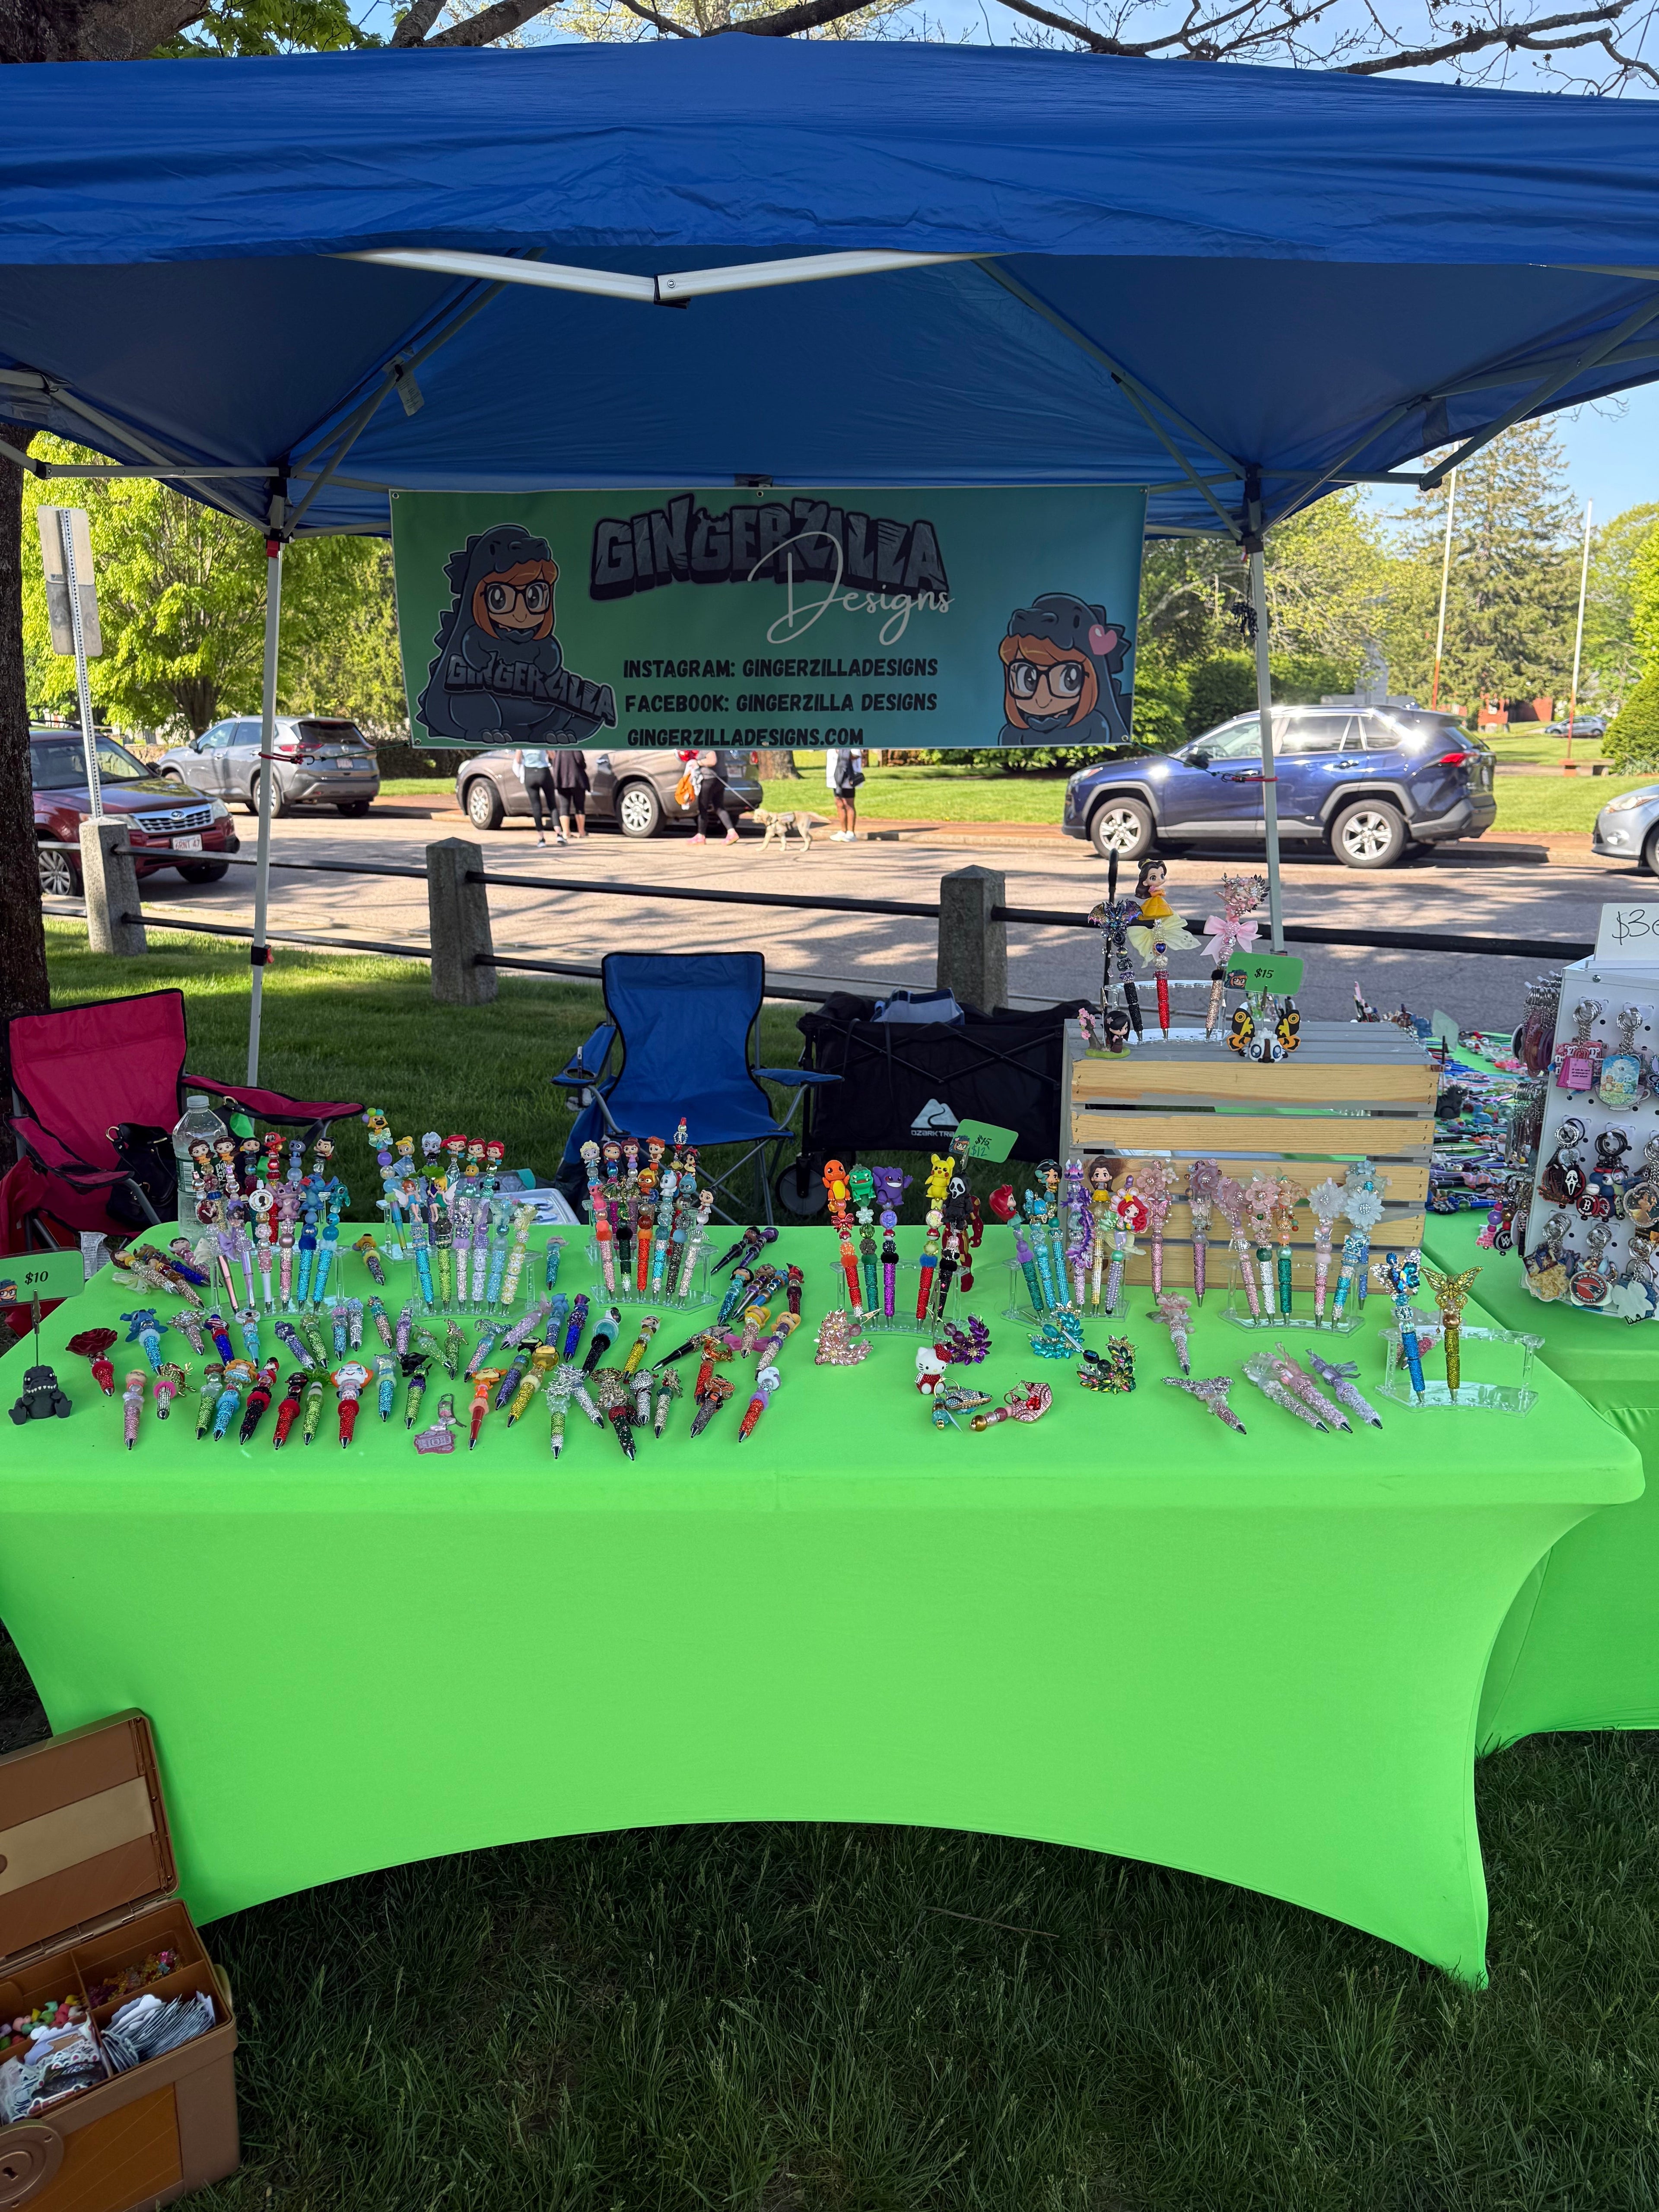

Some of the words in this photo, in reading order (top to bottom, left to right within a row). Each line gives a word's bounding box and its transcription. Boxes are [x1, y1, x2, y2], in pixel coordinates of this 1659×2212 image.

[590, 493, 949, 601] GINGERZILLA
[747, 531, 955, 645] Designs
[623, 659, 735, 677] INSTAGRAM:
[743, 658, 938, 677] GINGERZILLADESIGNS
[625, 694, 729, 712] FACEBOOK:
[737, 693, 854, 712] GINGERZILLA
[861, 693, 937, 711] DESIGNS
[627, 728, 863, 746] GINGERZILLADESIGNS.COM
[1255, 968, 1274, 978] $15
[971, 1145, 988, 1157] $12
[25, 1271, 48, 1285] $10
